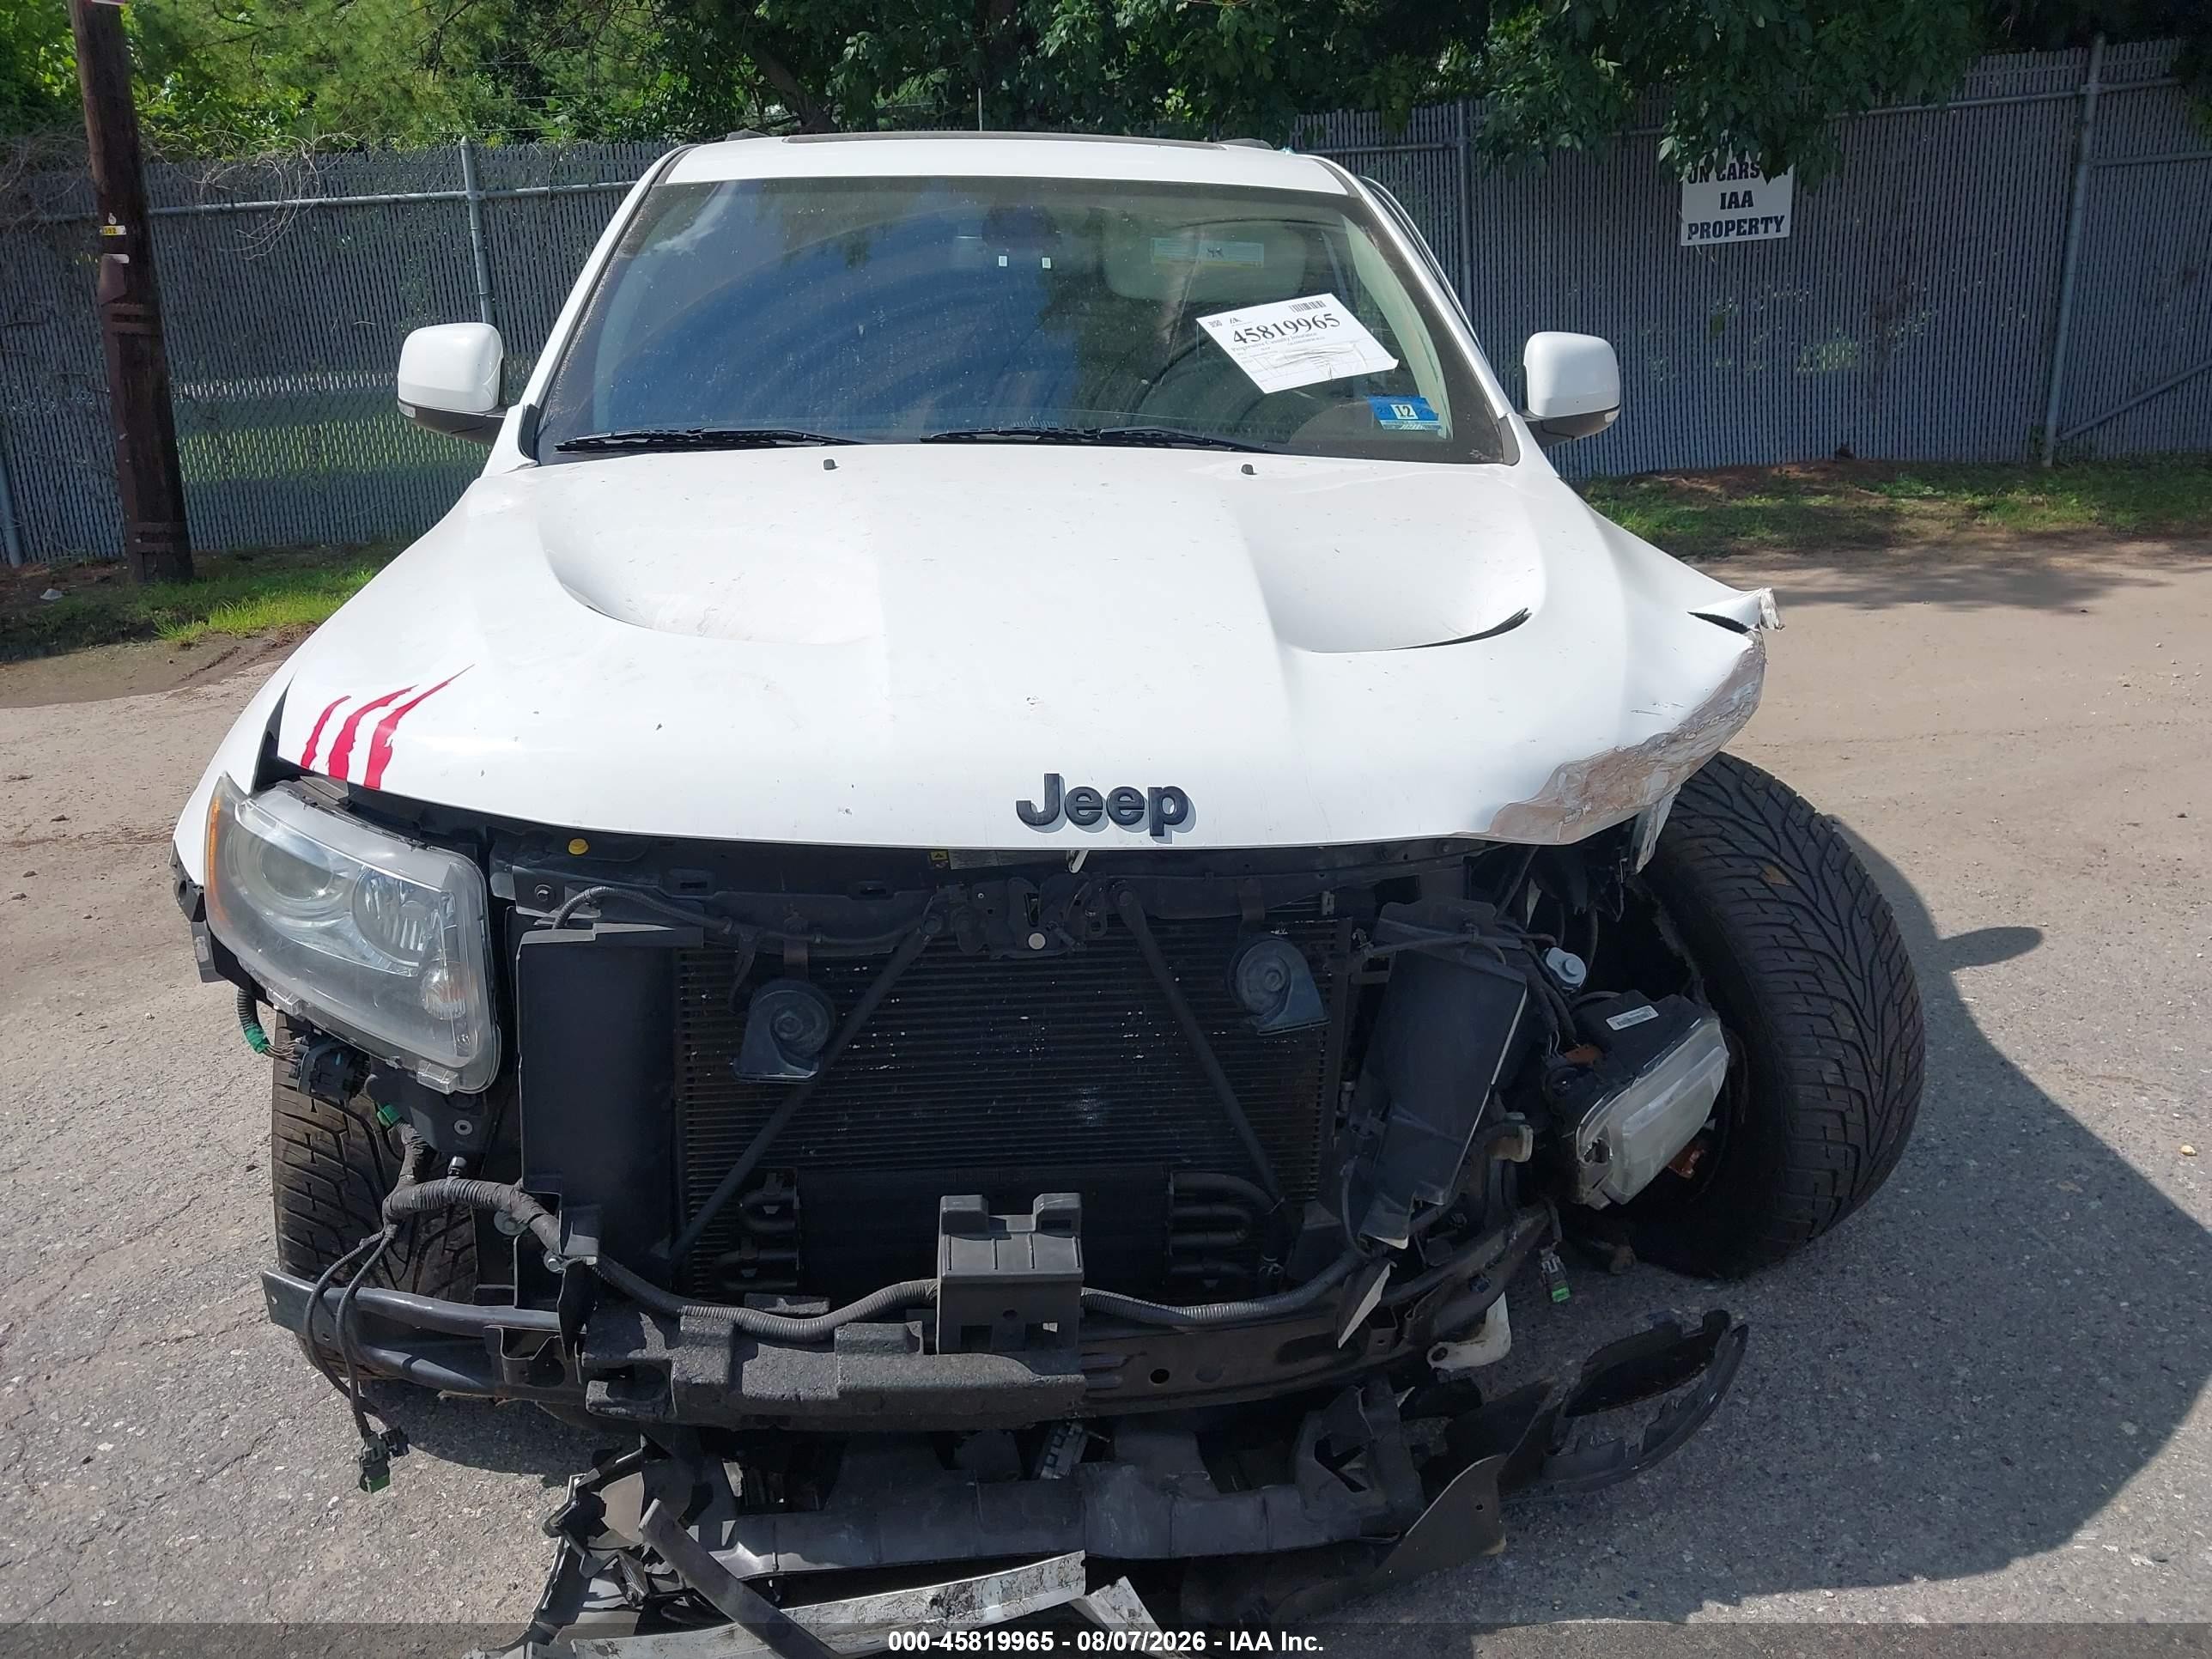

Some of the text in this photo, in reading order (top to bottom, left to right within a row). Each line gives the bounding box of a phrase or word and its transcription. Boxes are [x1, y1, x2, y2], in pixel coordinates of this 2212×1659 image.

[1717, 161, 1760, 181] CARS
[1720, 190, 1754, 210] IAA
[1687, 216, 1784, 240] PROPERTY
[1233, 313, 1340, 344] 45819965
[1395, 404, 1415, 418] 12
[1015, 773, 1190, 837] Jeep
